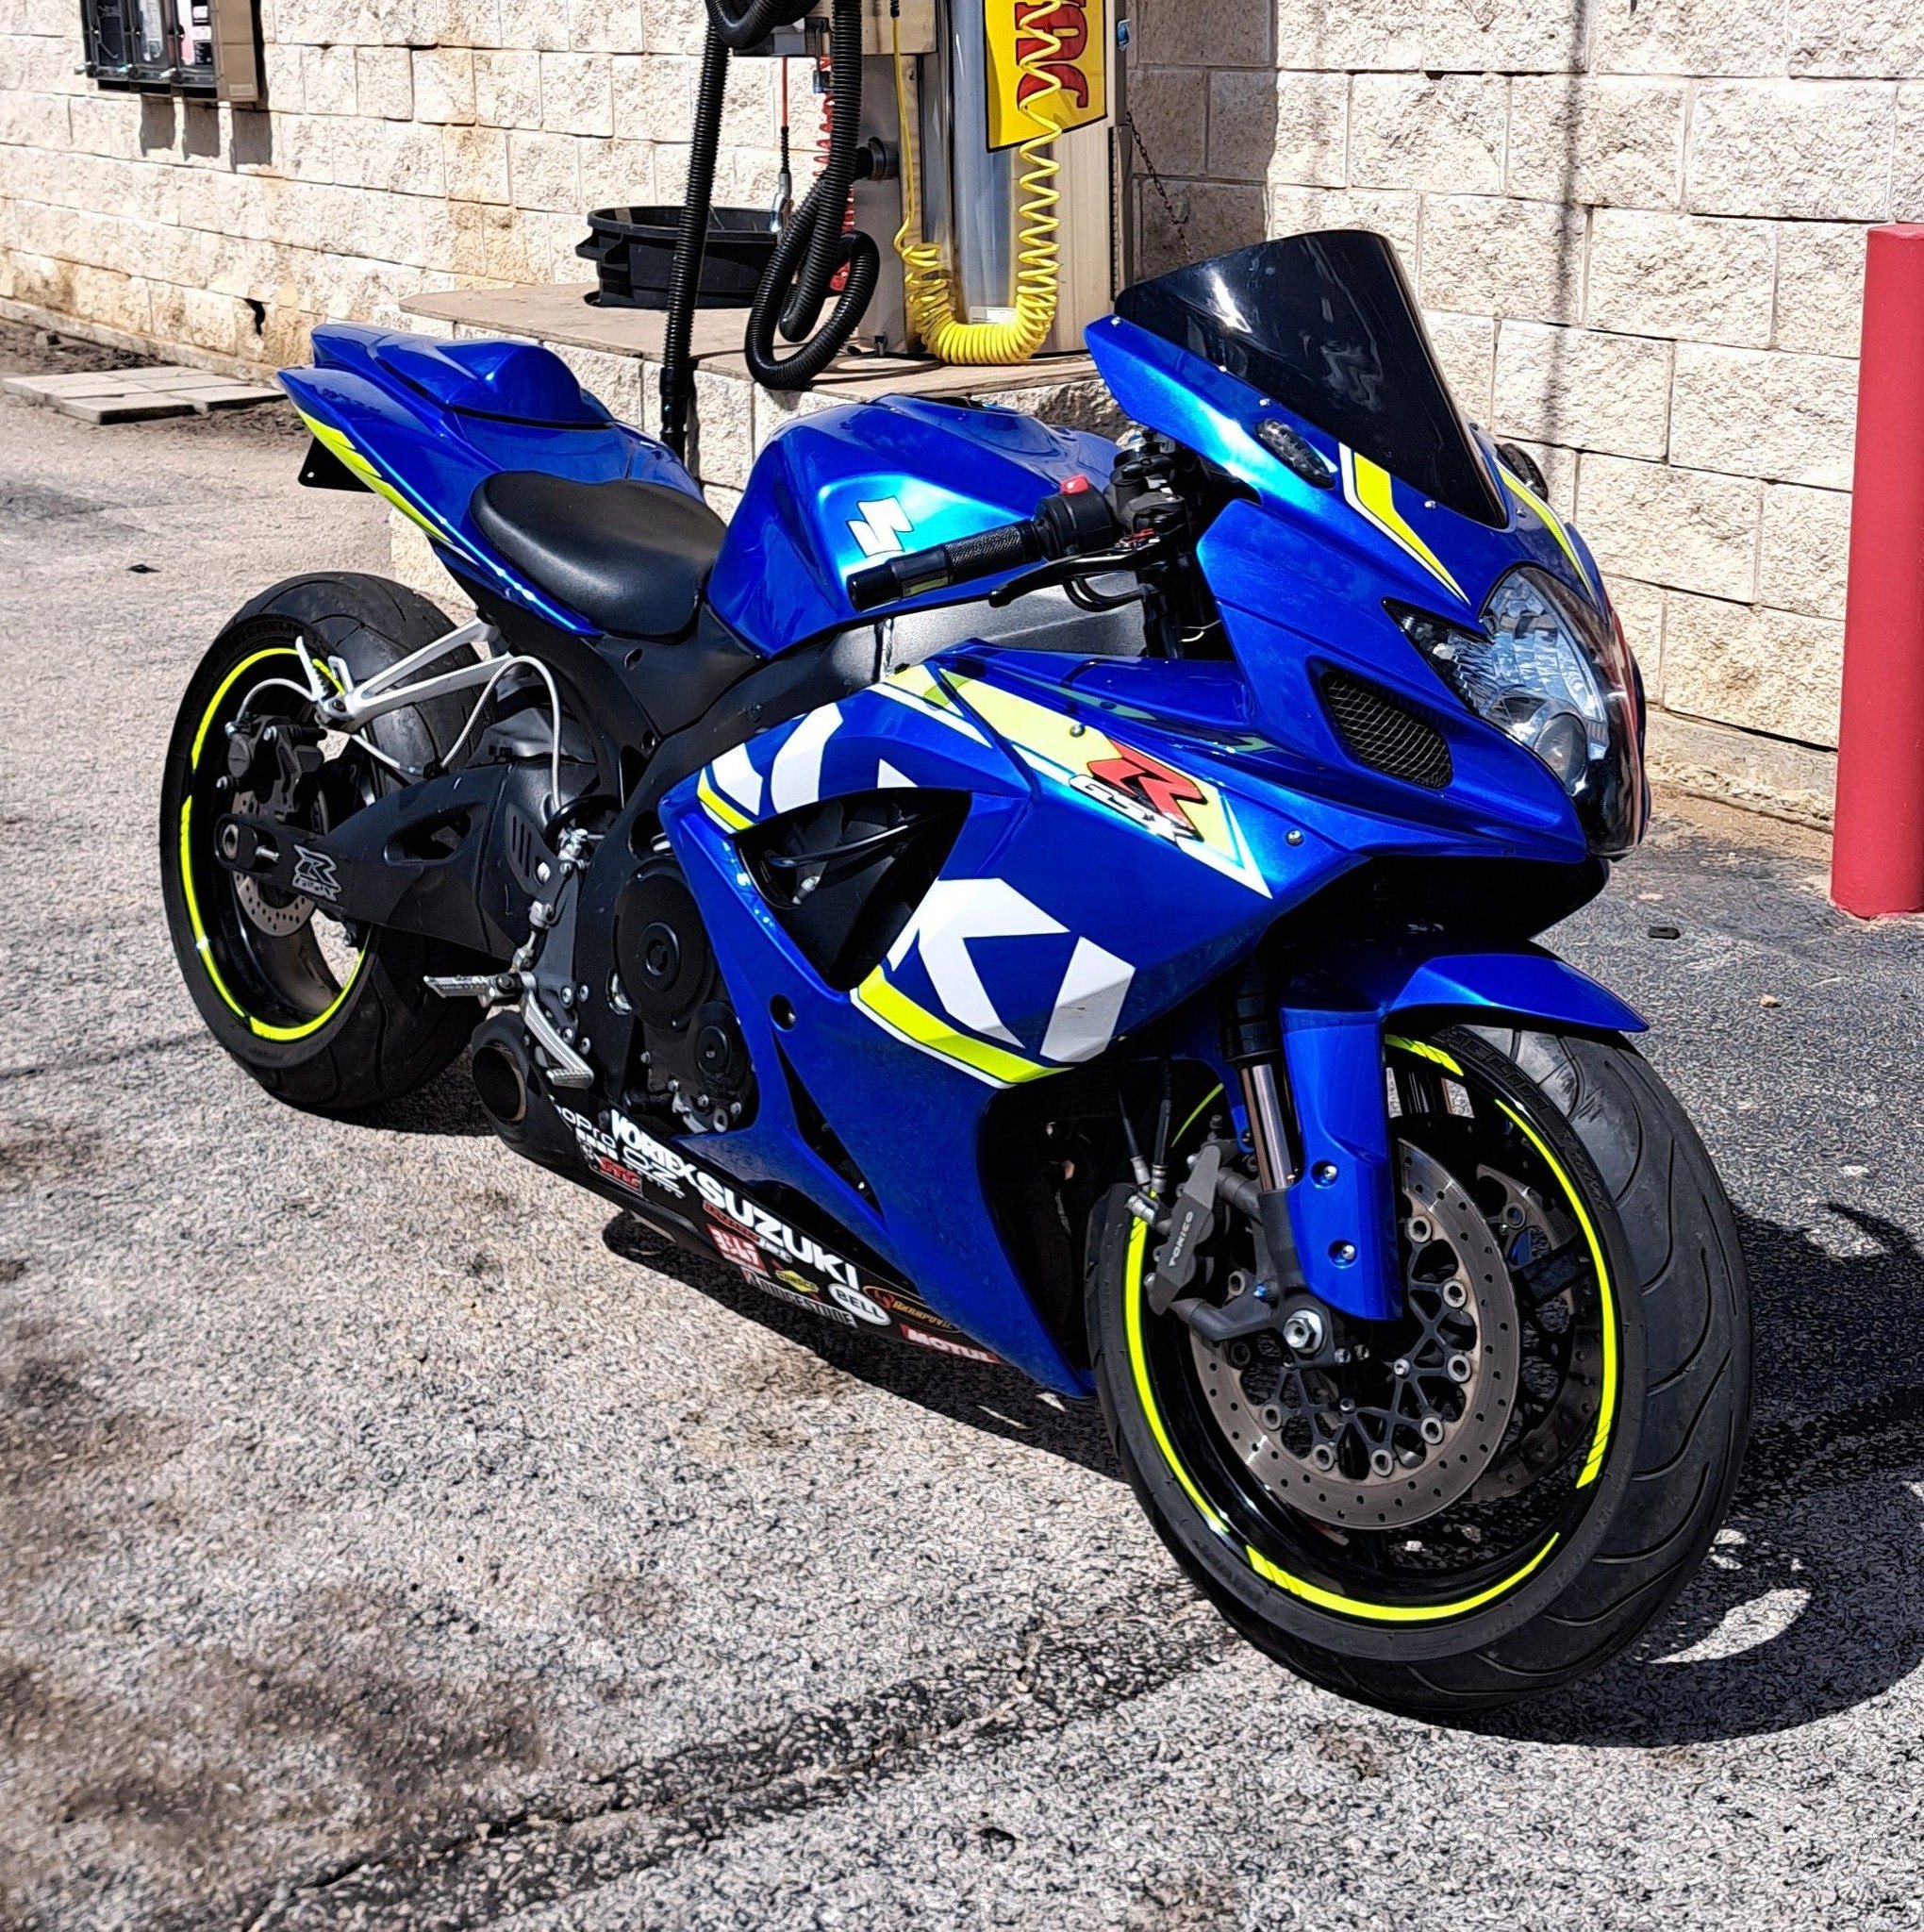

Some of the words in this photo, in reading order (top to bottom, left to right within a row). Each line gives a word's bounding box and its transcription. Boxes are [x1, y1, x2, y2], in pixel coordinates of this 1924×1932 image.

[1015, 0, 1089, 110] AC
[547, 1092, 617, 1150] oPro
[610, 1108, 699, 1191] VORTEX
[696, 1171, 859, 1291] SUZUKI
[1168, 1209, 1195, 1267] TOKICO
[837, 1289, 885, 1320] BELL
[906, 1327, 994, 1363] MOTUL
